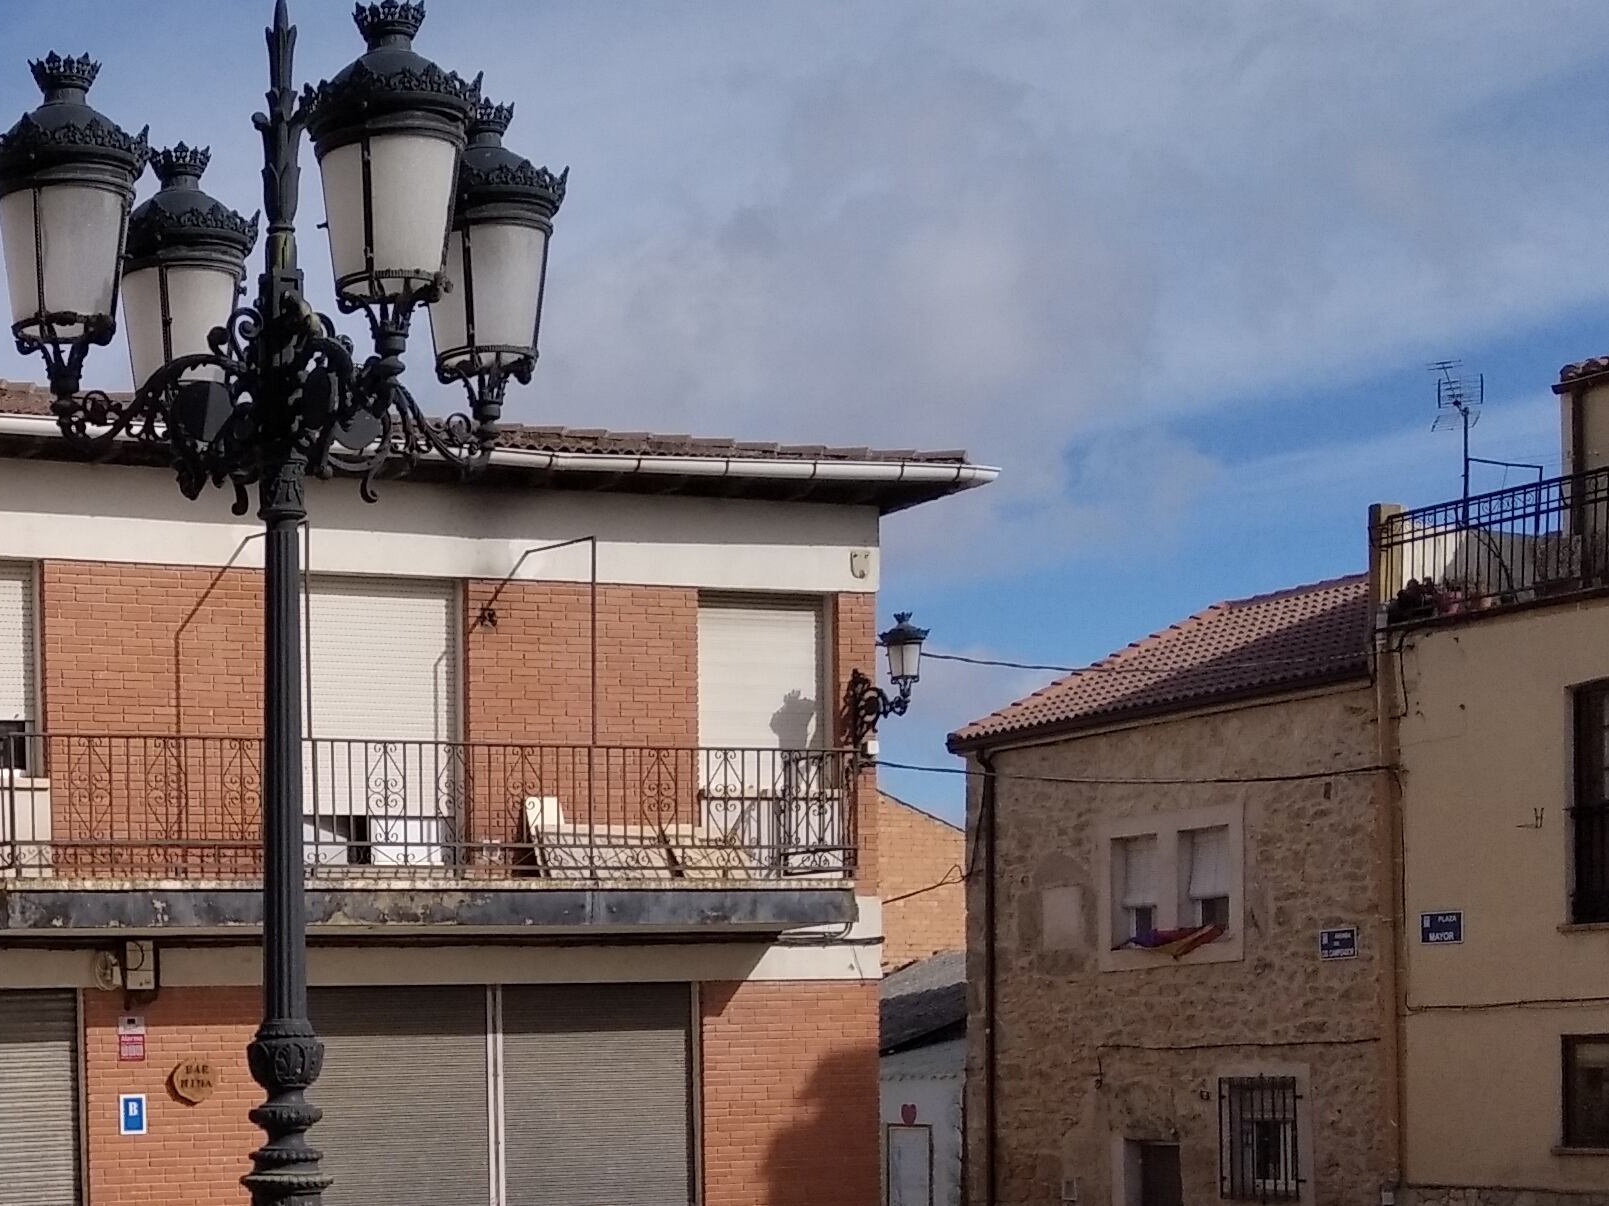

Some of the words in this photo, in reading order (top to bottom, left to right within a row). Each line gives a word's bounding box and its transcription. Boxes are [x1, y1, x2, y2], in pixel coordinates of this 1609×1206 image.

[1437, 914, 1457, 923] PLAZA
[1428, 931, 1454, 941] MAYOR
[127, 1101, 139, 1116] B
